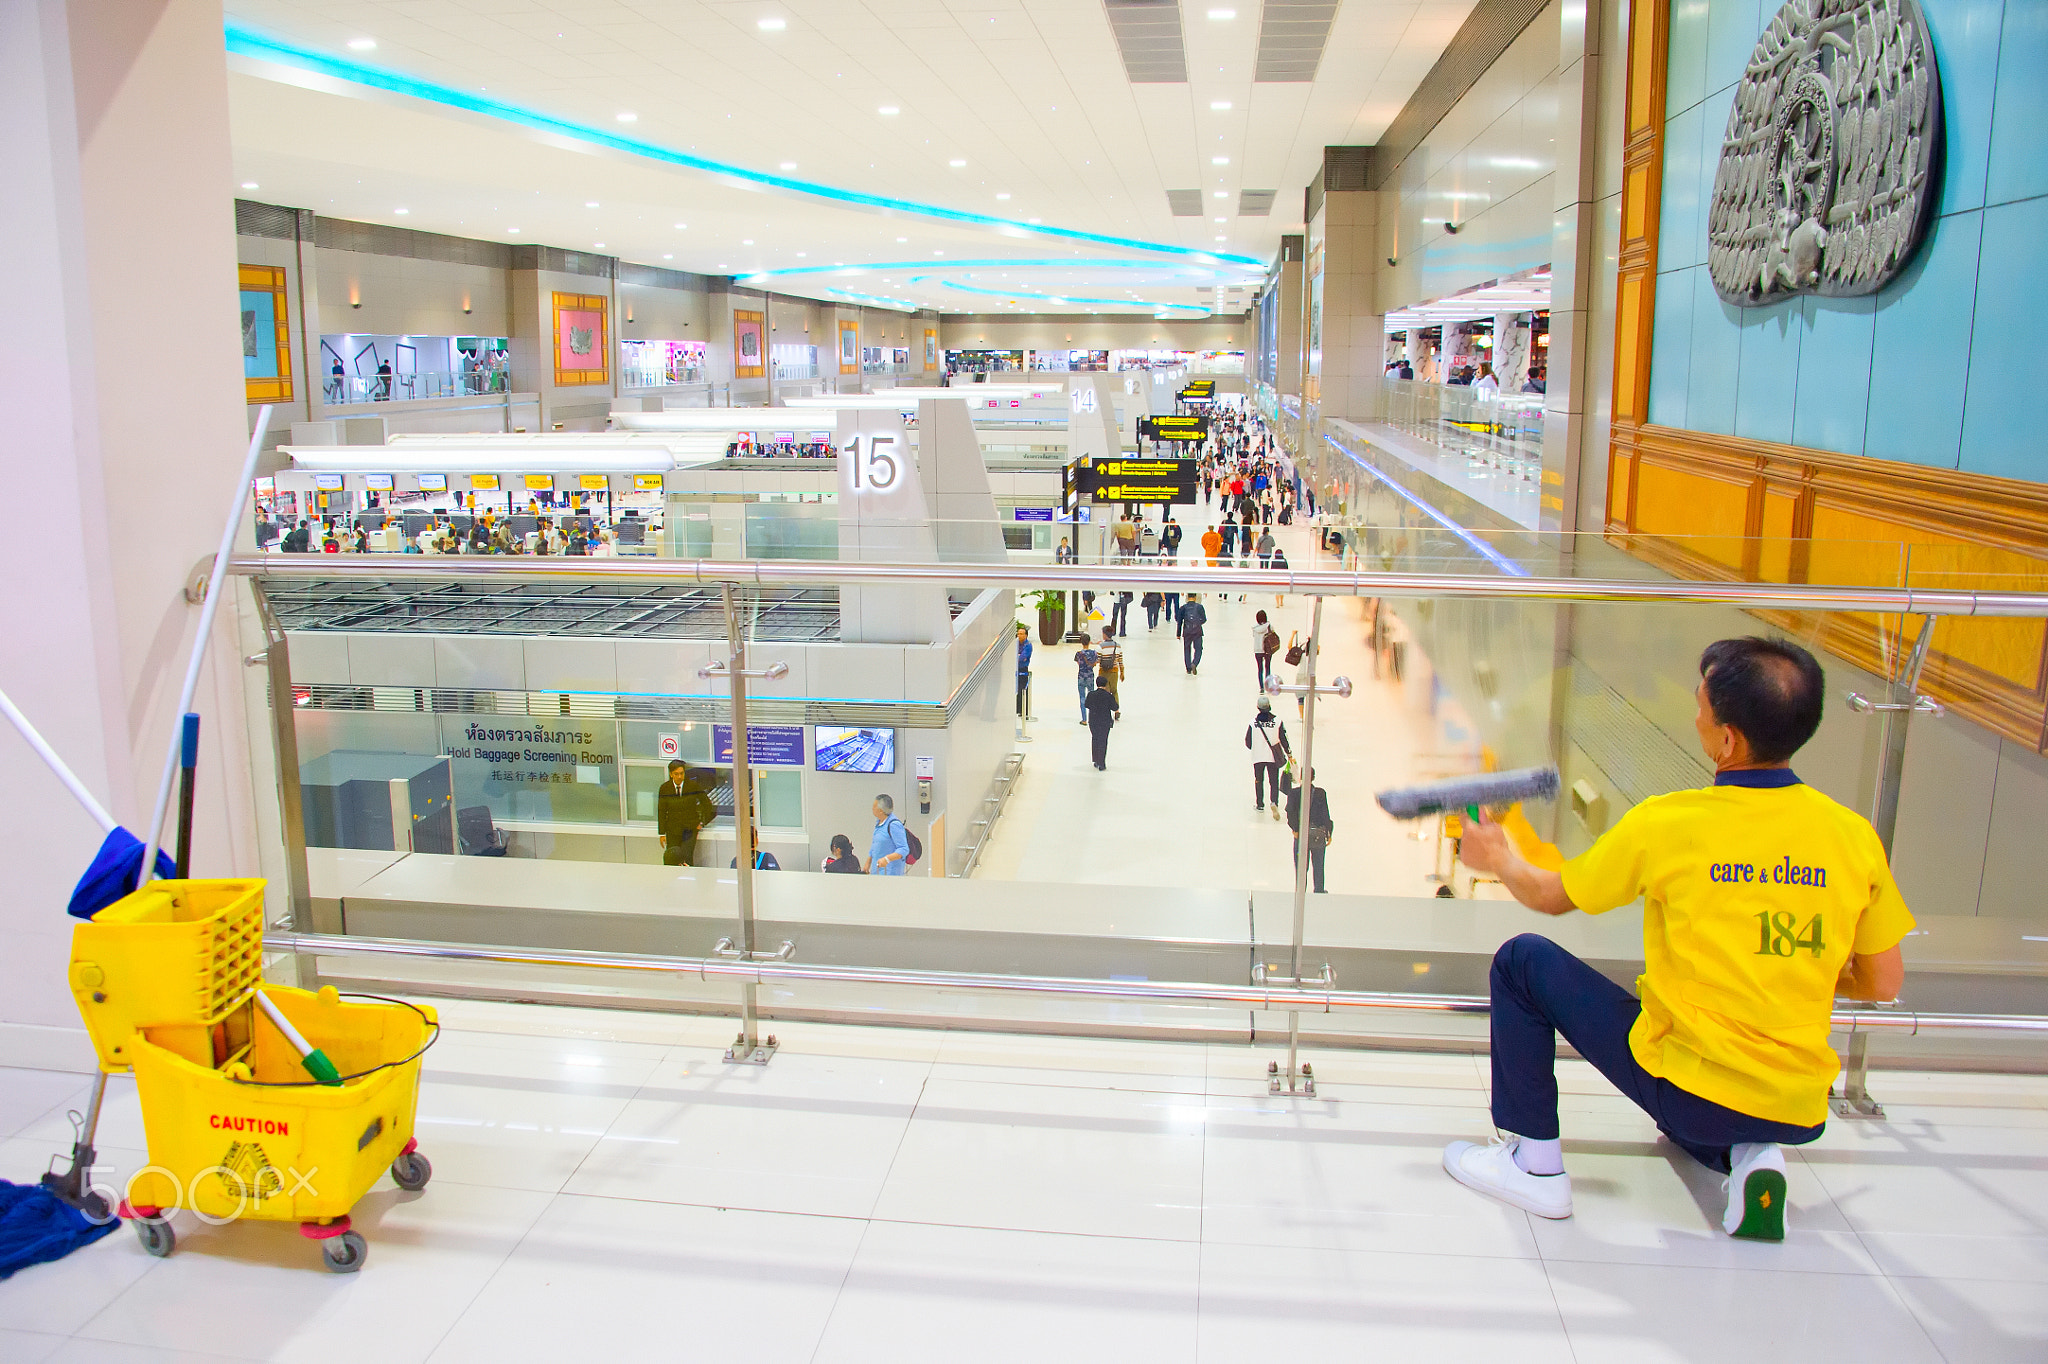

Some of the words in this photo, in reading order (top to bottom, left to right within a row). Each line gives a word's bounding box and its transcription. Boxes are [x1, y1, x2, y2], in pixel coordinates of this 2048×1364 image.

[1125, 379, 1141, 395] 12
[1070, 389, 1096, 413] 14
[844, 436, 896, 489] 15
[465, 722, 592, 746] ห้องตรวจสัมภาระ
[447, 747, 471, 759] Hold
[475, 748, 521, 763] Baggage
[524, 749, 577, 765] Screening
[581, 751, 613, 765] Room
[1709, 863, 1754, 883] care
[1759, 868, 1768, 883] &
[1773, 855, 1826, 888] clean
[1753, 910, 1826, 958] 184
[210, 1114, 289, 1137] CAUTION
[252, 1142, 284, 1191] ATTENTION
